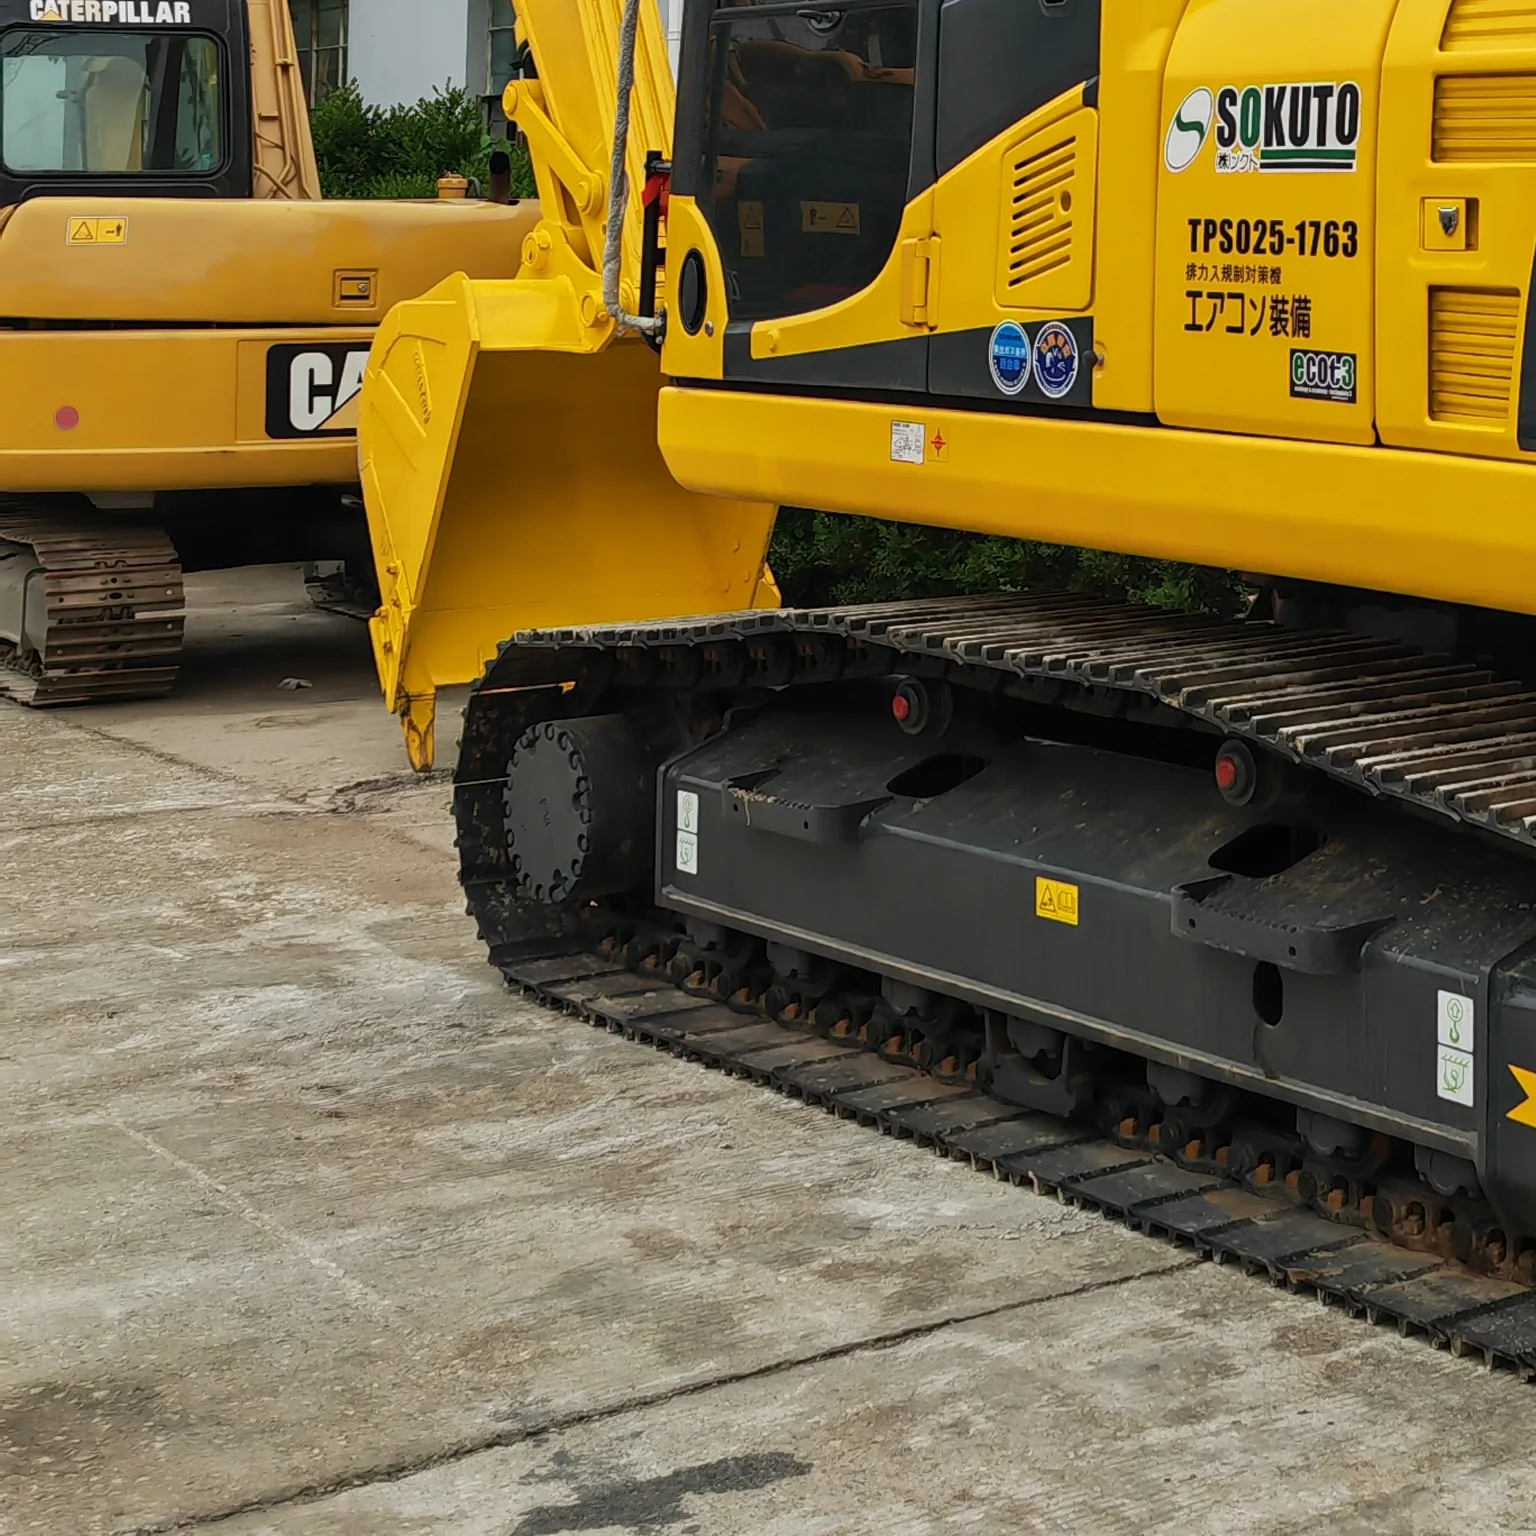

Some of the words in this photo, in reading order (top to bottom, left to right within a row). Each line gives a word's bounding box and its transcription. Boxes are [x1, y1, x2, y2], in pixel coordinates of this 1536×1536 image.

[1216, 83, 1360, 148] SOKUTO
[1184, 289, 1312, 339] エアコン装備
[1292, 352, 1354, 390] ecot3
